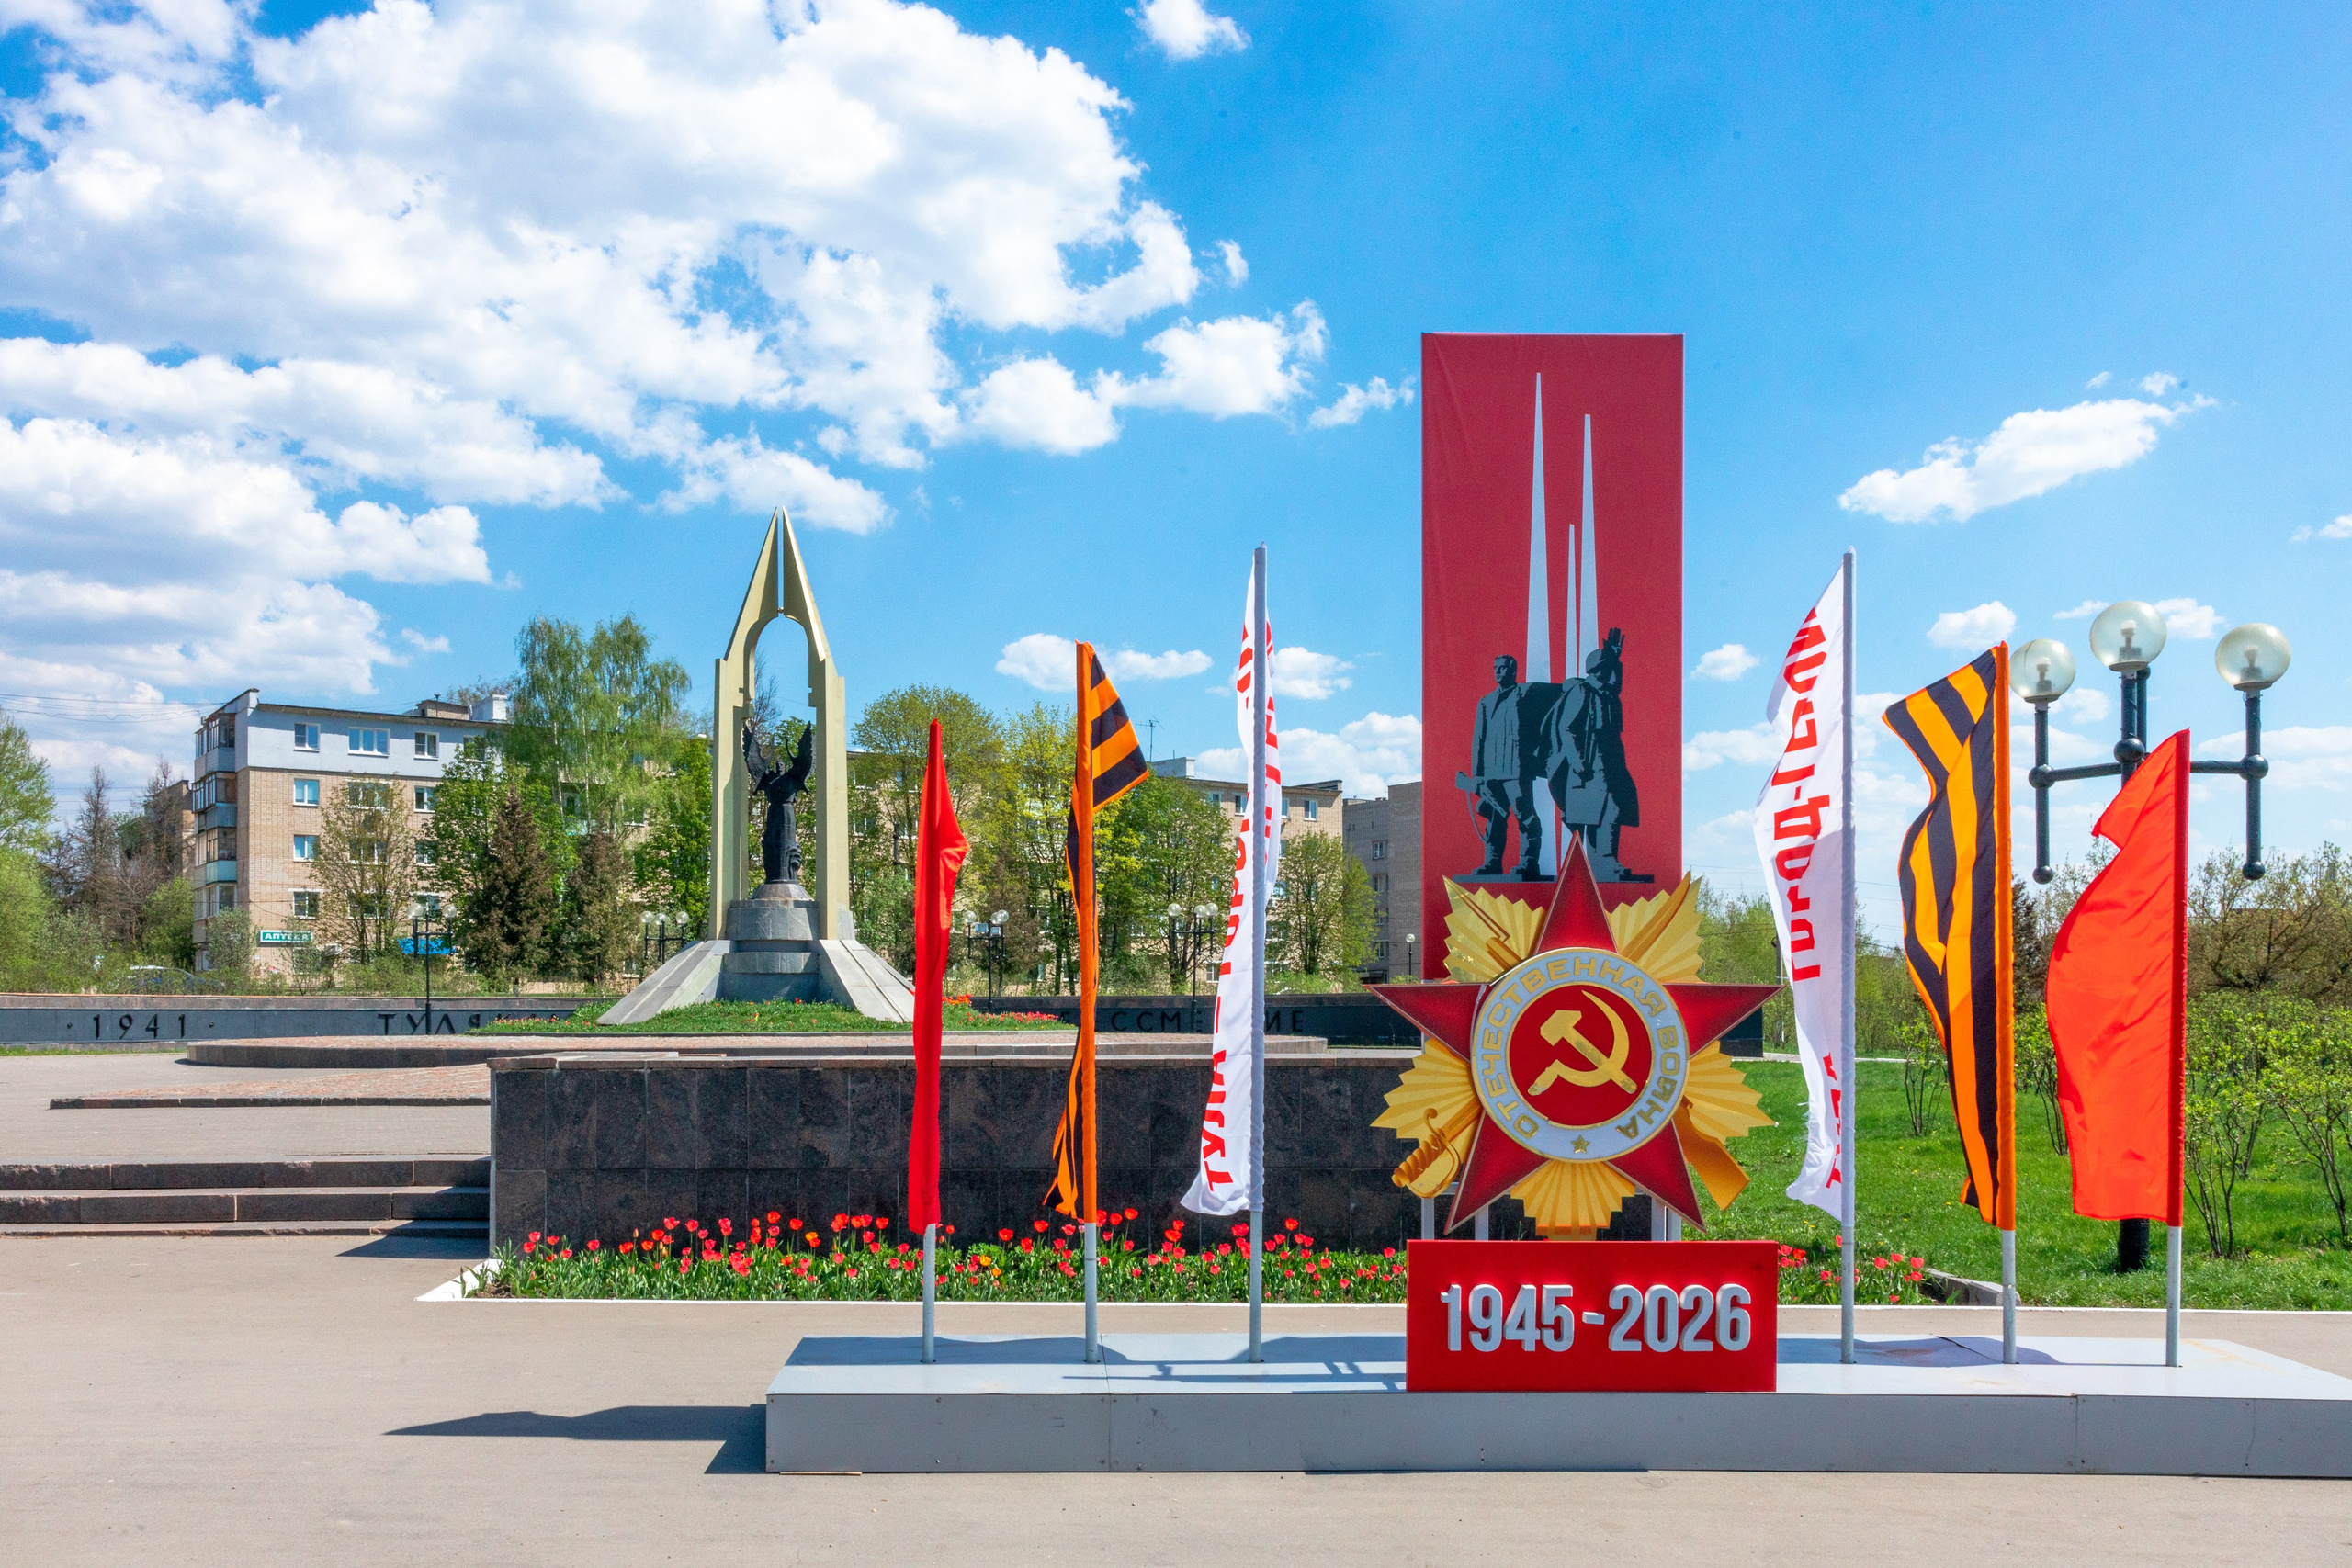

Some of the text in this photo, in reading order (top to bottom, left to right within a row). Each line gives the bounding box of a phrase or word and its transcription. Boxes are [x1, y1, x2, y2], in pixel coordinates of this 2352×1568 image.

[93, 1013, 186, 1040] 1941
[1482, 957, 1668, 1139] ОТЕЧЕСТВЕННАЯ
[1201, 1049, 1234, 1192] ТУЛА
[1440, 1283, 1752, 1353] 1945-2026
